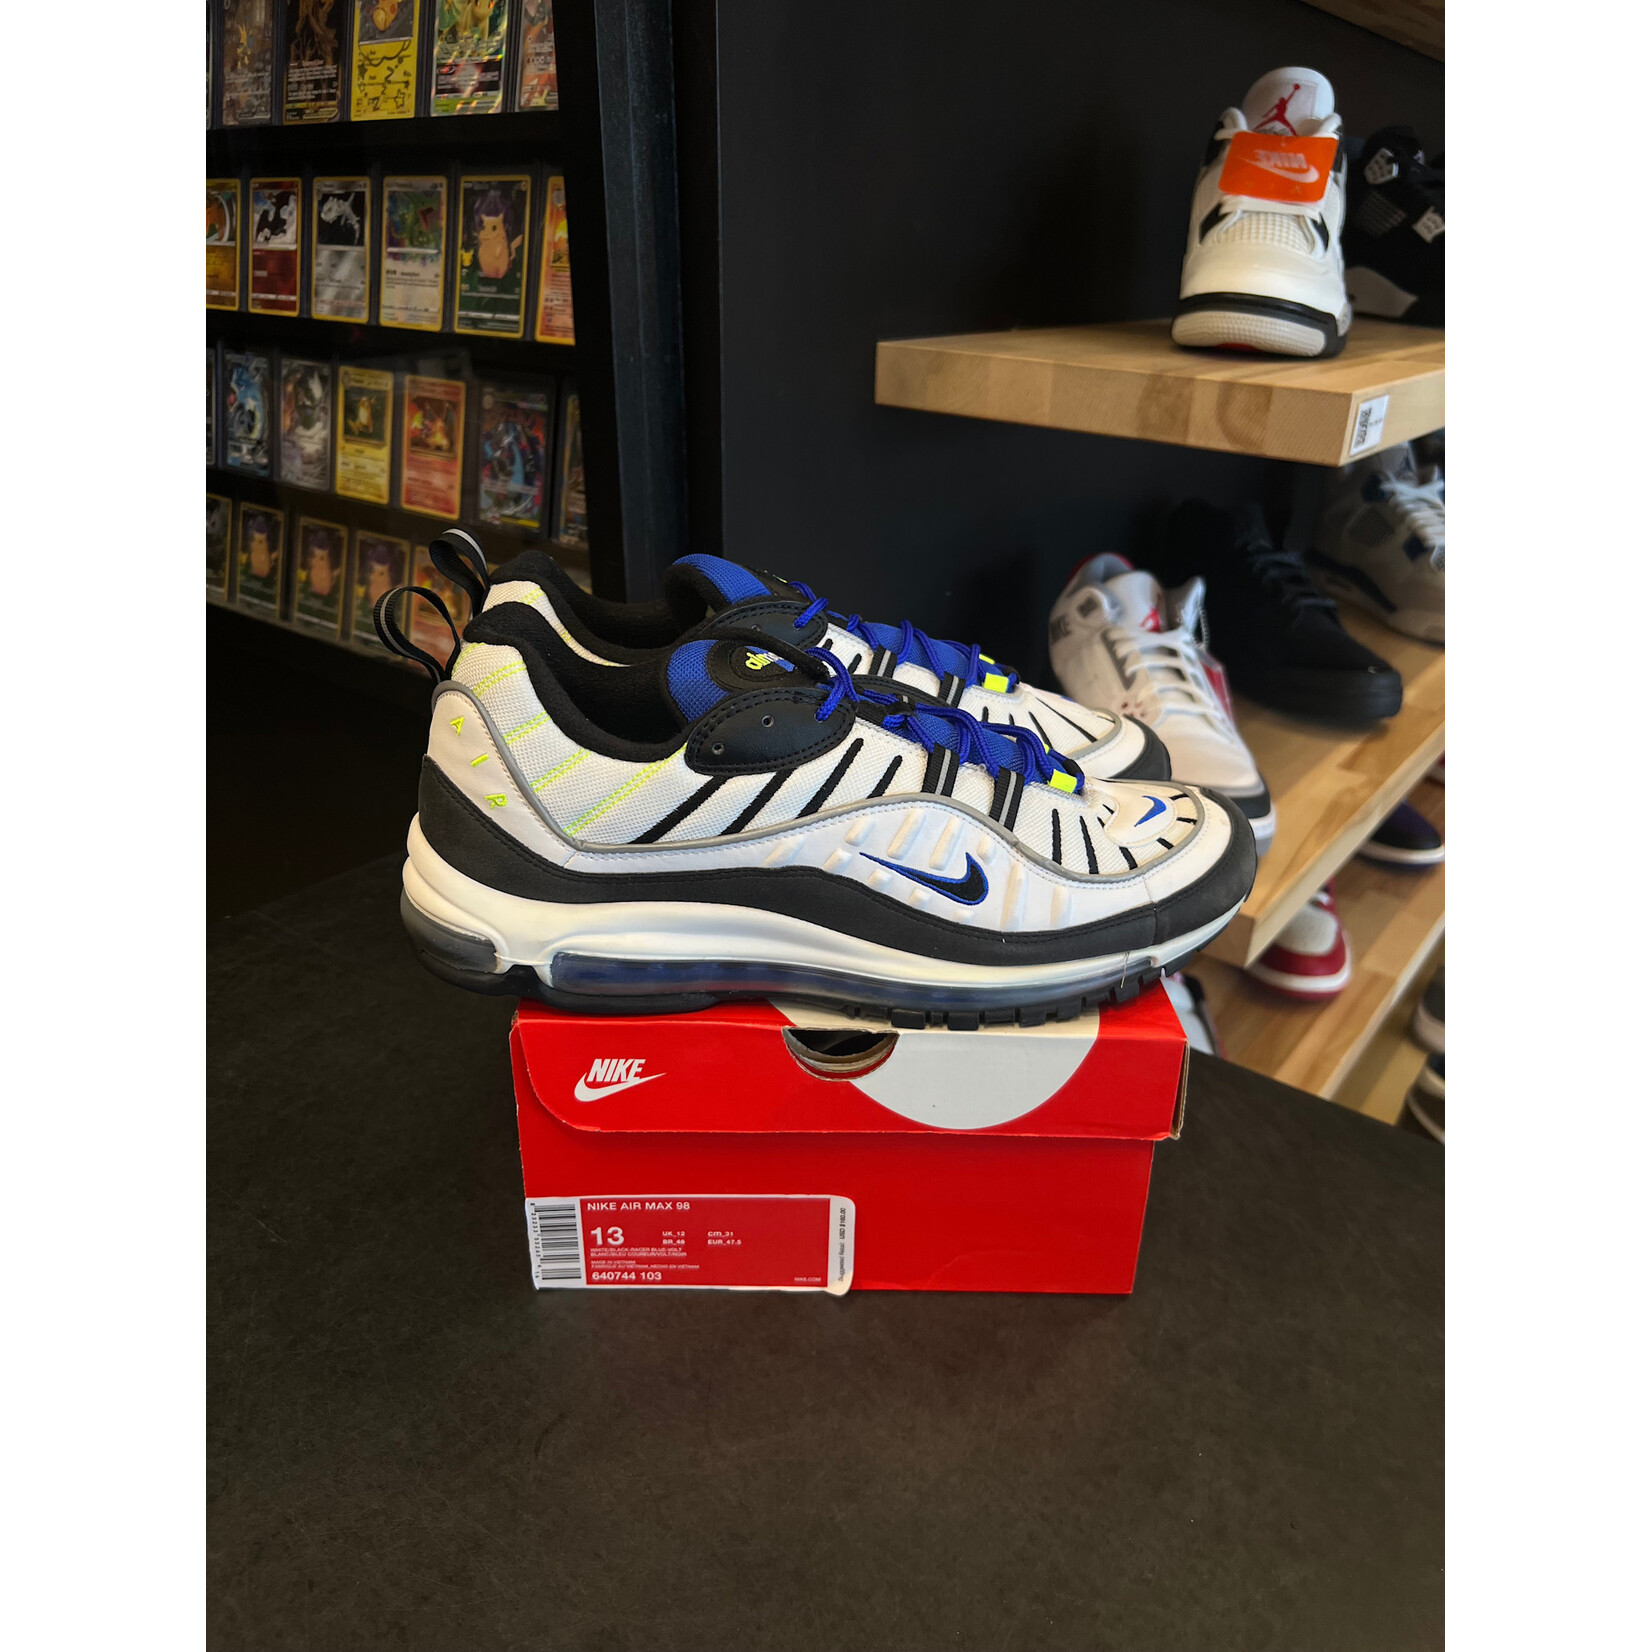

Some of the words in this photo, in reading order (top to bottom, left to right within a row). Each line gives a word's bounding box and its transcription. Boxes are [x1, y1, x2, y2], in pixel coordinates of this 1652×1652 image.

[586, 1058, 647, 1083] NIKE
[587, 1201, 617, 1211] NIKE
[620, 1201, 642, 1210] AIR
[645, 1201, 673, 1210] MAX
[676, 1201, 690, 1210] 98
[590, 1226, 625, 1246] 13
[662, 1230, 686, 1238] UK_12
[591, 1271, 637, 1280] 640744
[640, 1271, 662, 1280] 103
